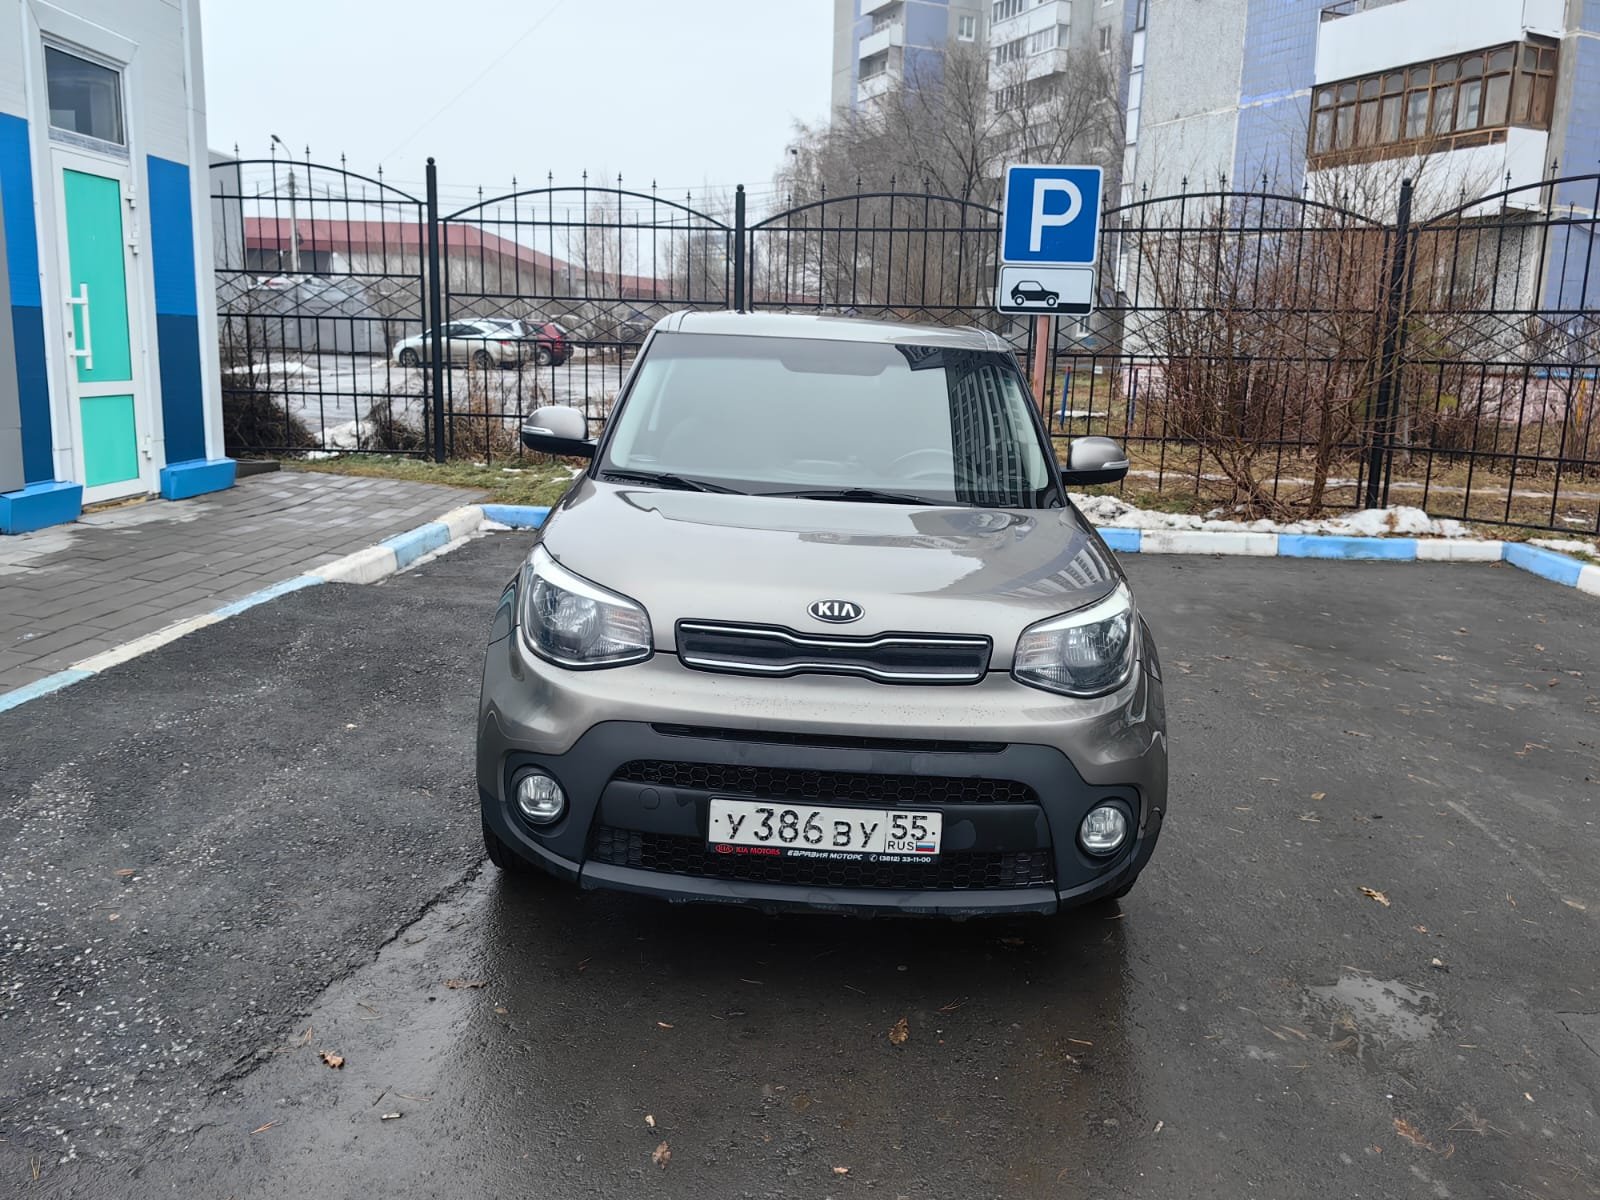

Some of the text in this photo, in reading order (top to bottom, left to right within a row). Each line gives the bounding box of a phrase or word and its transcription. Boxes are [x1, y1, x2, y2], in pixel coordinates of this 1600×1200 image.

[1029, 178, 1082, 252] P
[818, 602, 855, 617] KIA
[891, 814, 928, 841] 55
[750, 848, 781, 856] MOTORS
[887, 841, 914, 851] RUS
[829, 852, 863, 861] МОТОРС
